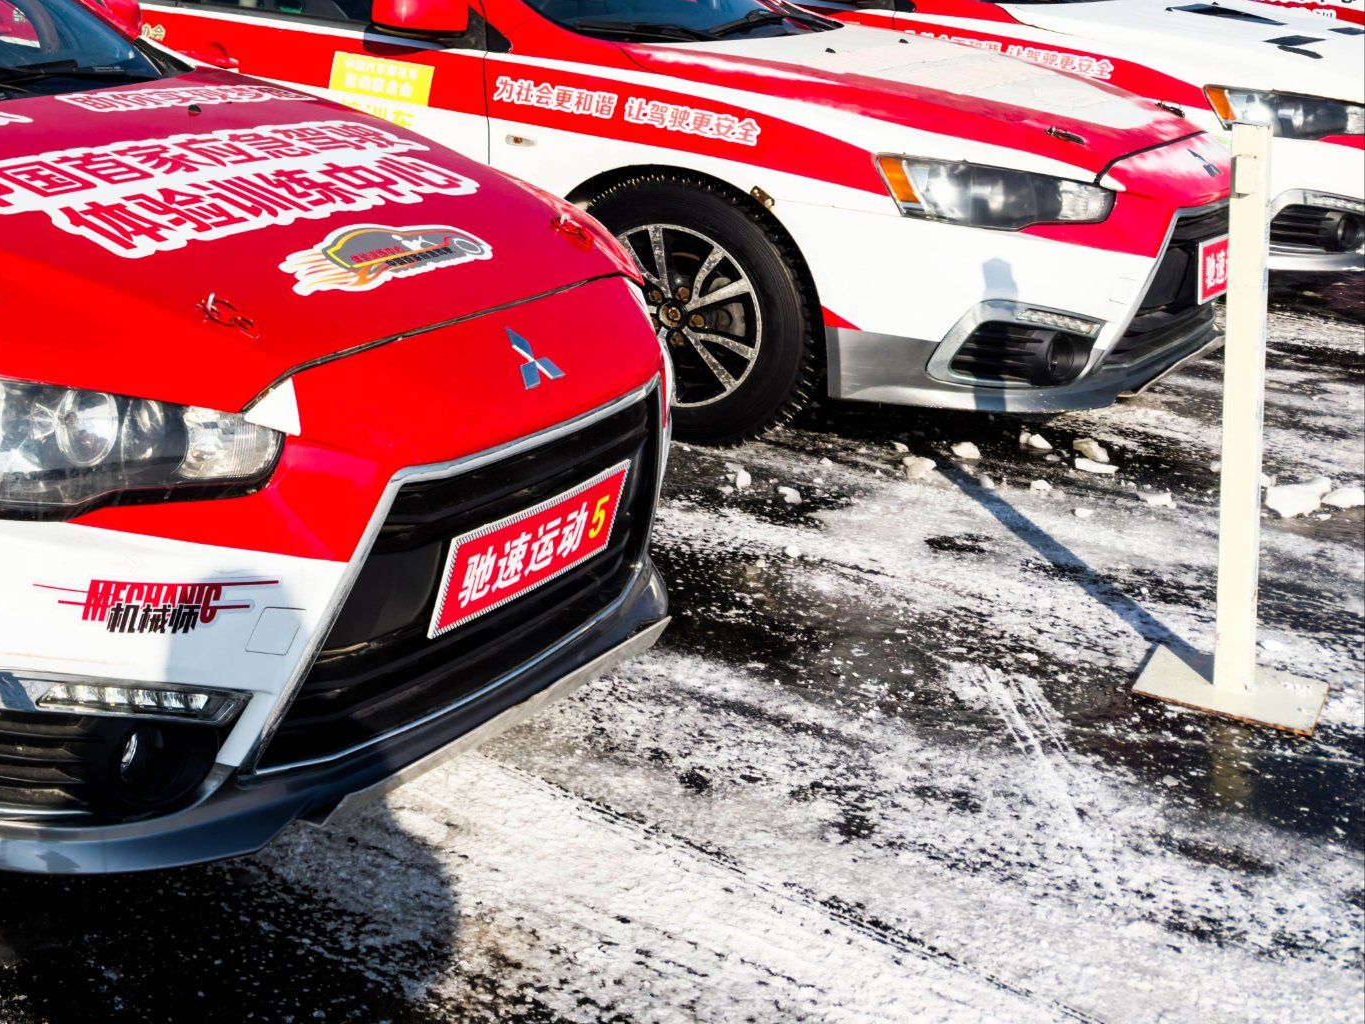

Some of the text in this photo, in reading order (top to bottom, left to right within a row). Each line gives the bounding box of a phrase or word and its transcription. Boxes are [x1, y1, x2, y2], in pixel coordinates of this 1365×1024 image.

[494, 78, 759, 143] 为社会更和谐 让驾驶更安全
[58, 156, 463, 251] 体验训练中心
[1205, 249, 1229, 290] 驰速
[81, 579, 222, 624] MECHANIC
[106, 601, 202, 634] 机械师
